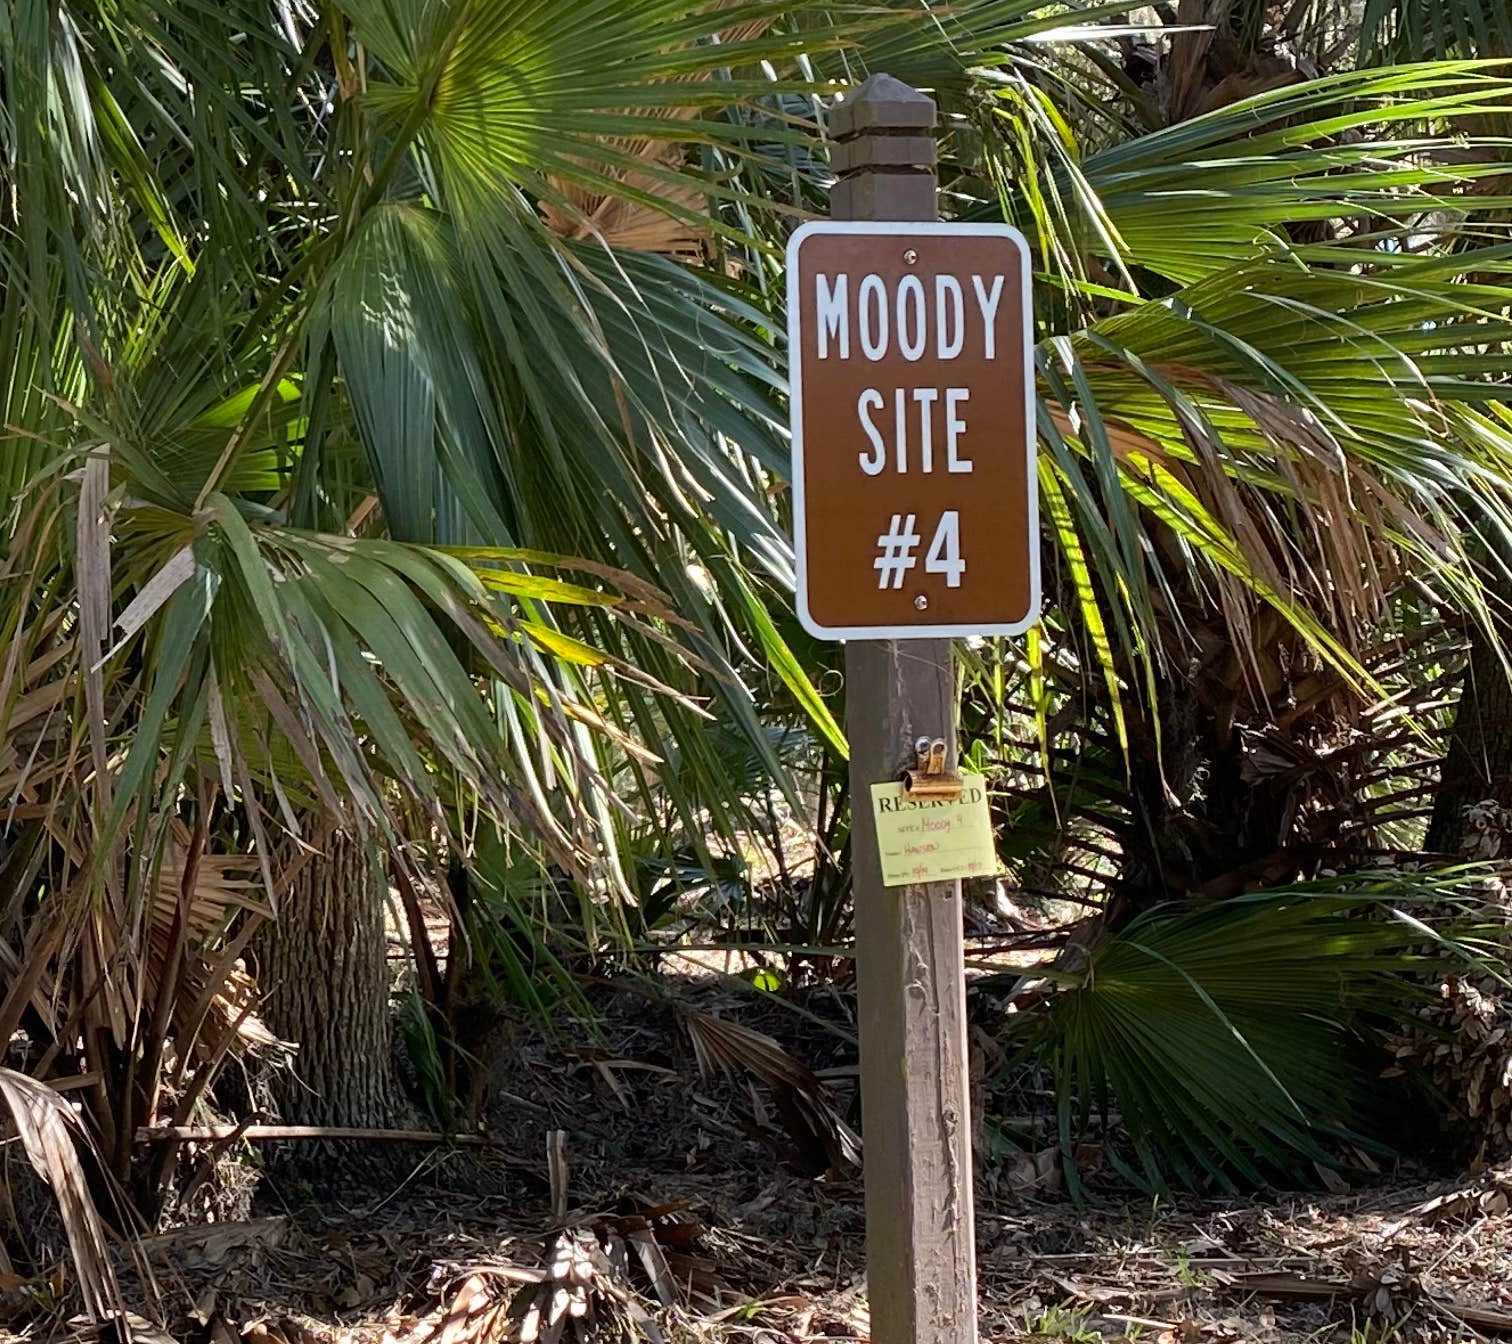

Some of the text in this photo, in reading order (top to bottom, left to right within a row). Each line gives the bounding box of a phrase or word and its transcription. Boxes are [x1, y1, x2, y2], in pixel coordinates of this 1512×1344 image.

[815, 272, 1005, 362] MOODY
[857, 386, 974, 477] SITE
[872, 509, 967, 591] #4
[878, 787, 982, 814] RESEED
